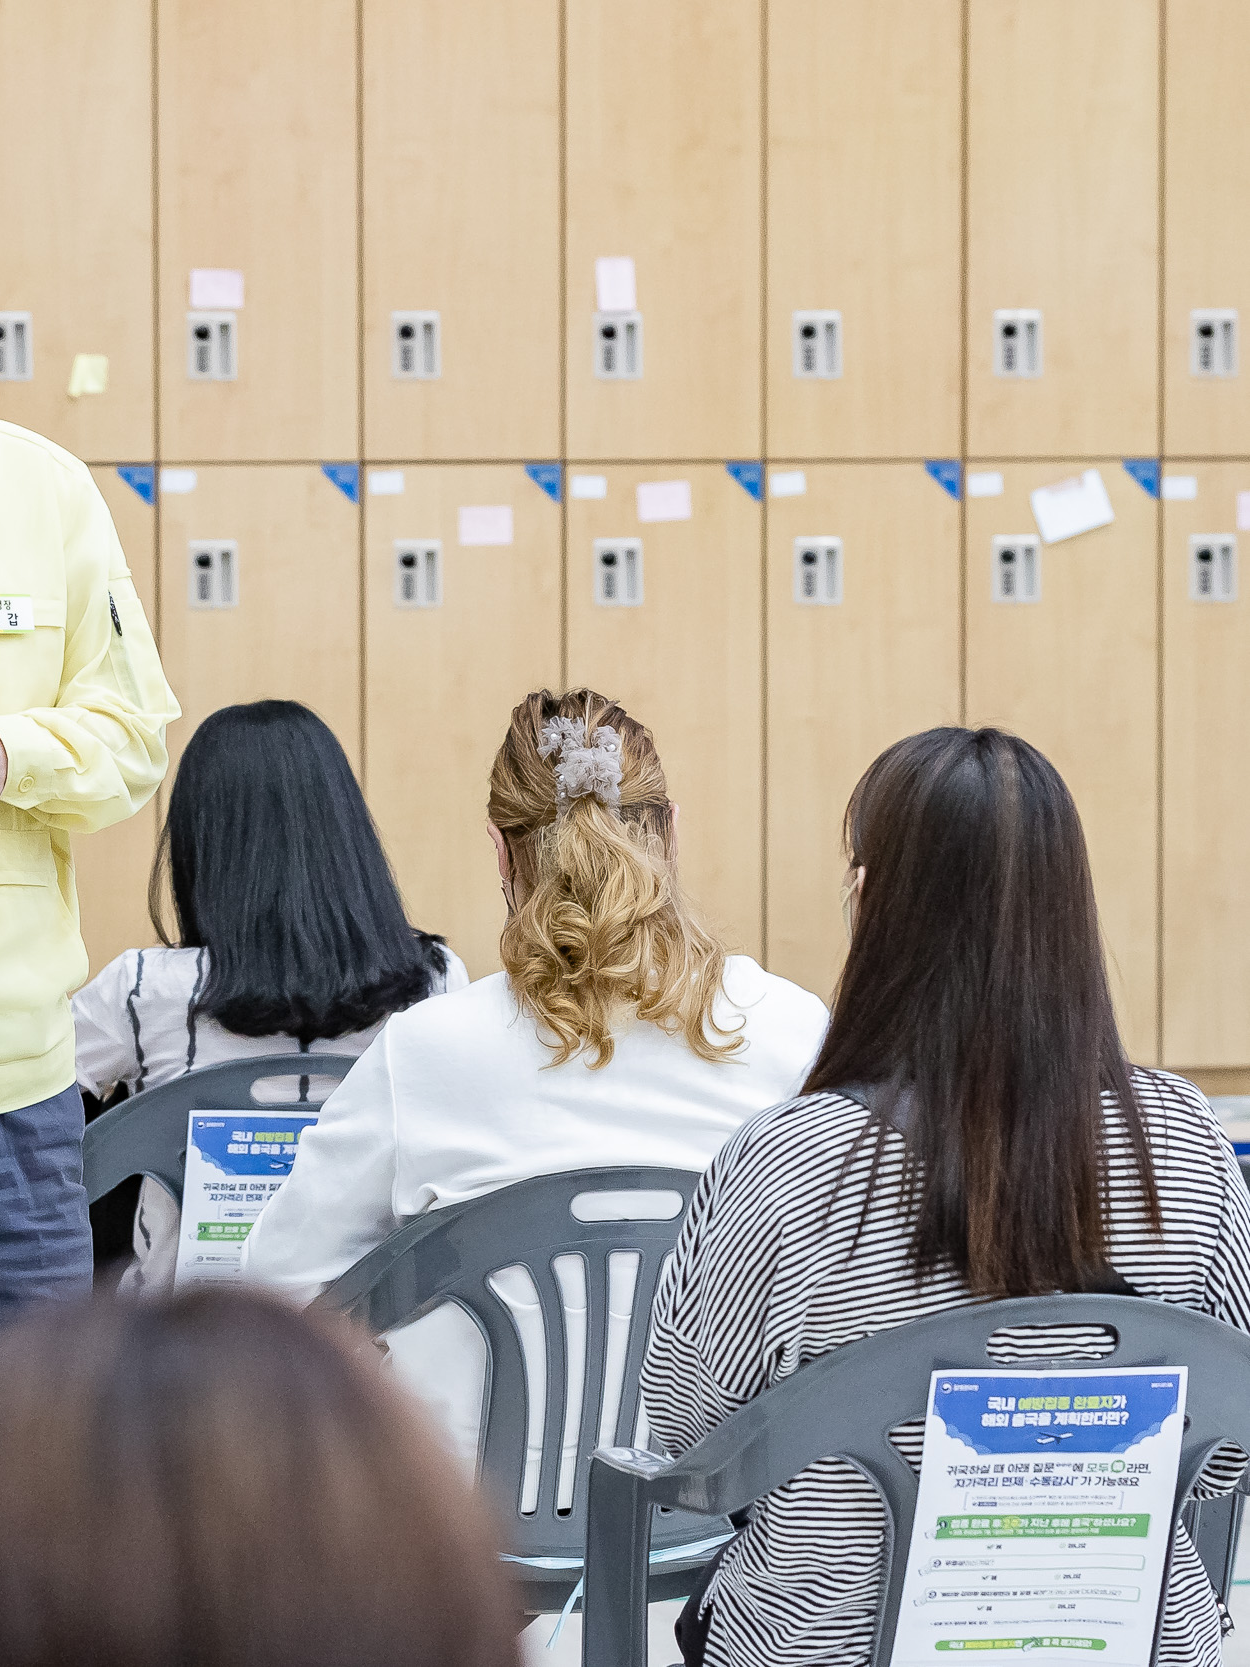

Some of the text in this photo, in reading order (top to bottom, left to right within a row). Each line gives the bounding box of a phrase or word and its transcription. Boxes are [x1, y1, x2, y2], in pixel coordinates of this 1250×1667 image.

[987, 1396, 1016, 1412] 국내
[981, 1412, 1010, 1428] 해외
[1053, 1411, 1130, 1427] 계획한다면?
[946, 1464, 991, 1477] 귀국하실
[1007, 1462, 1030, 1473] 아래
[1086, 1462, 1109, 1473] 모두
[953, 1476, 999, 1488] 자가격리
[1094, 1476, 1140, 1488] 가능해요
